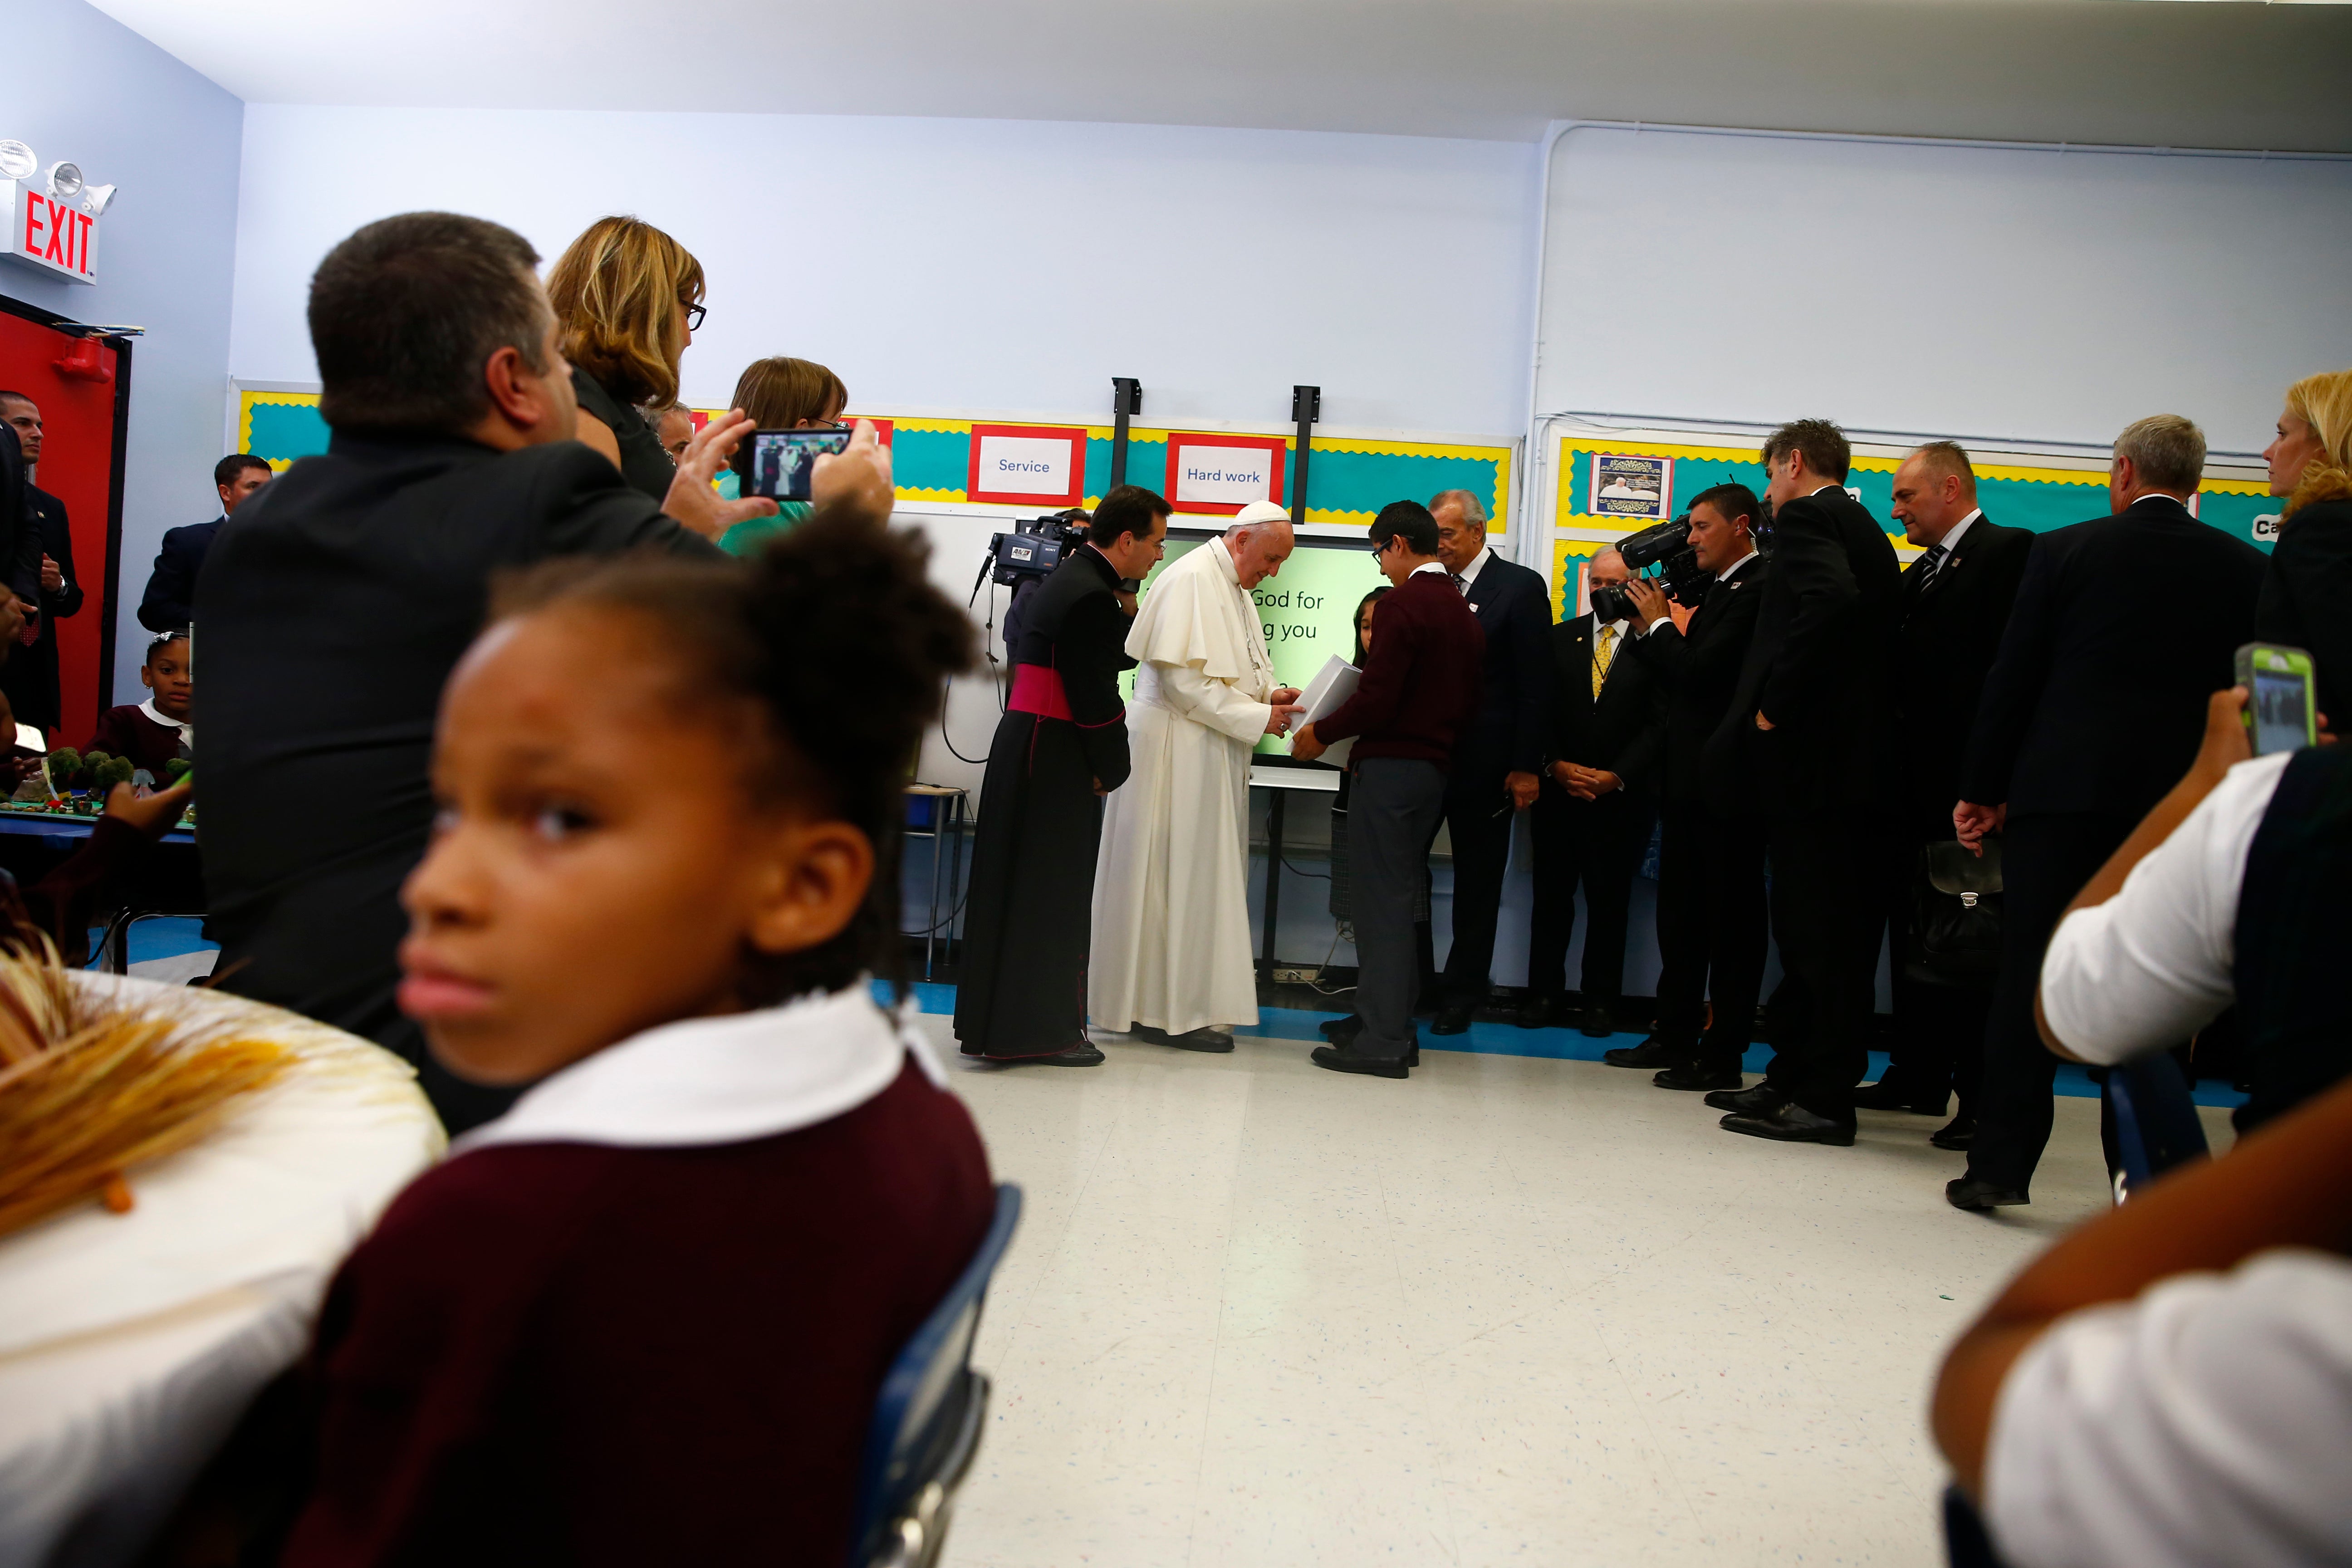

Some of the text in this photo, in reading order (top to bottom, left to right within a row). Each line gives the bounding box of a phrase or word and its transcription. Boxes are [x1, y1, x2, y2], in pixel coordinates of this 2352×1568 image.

[26, 190, 93, 274] EXIT
[999, 459, 1049, 472] Service
[1188, 468, 1260, 483] Hard work
[1251, 589, 1324, 609] God for
[1281, 624, 1316, 642] you
